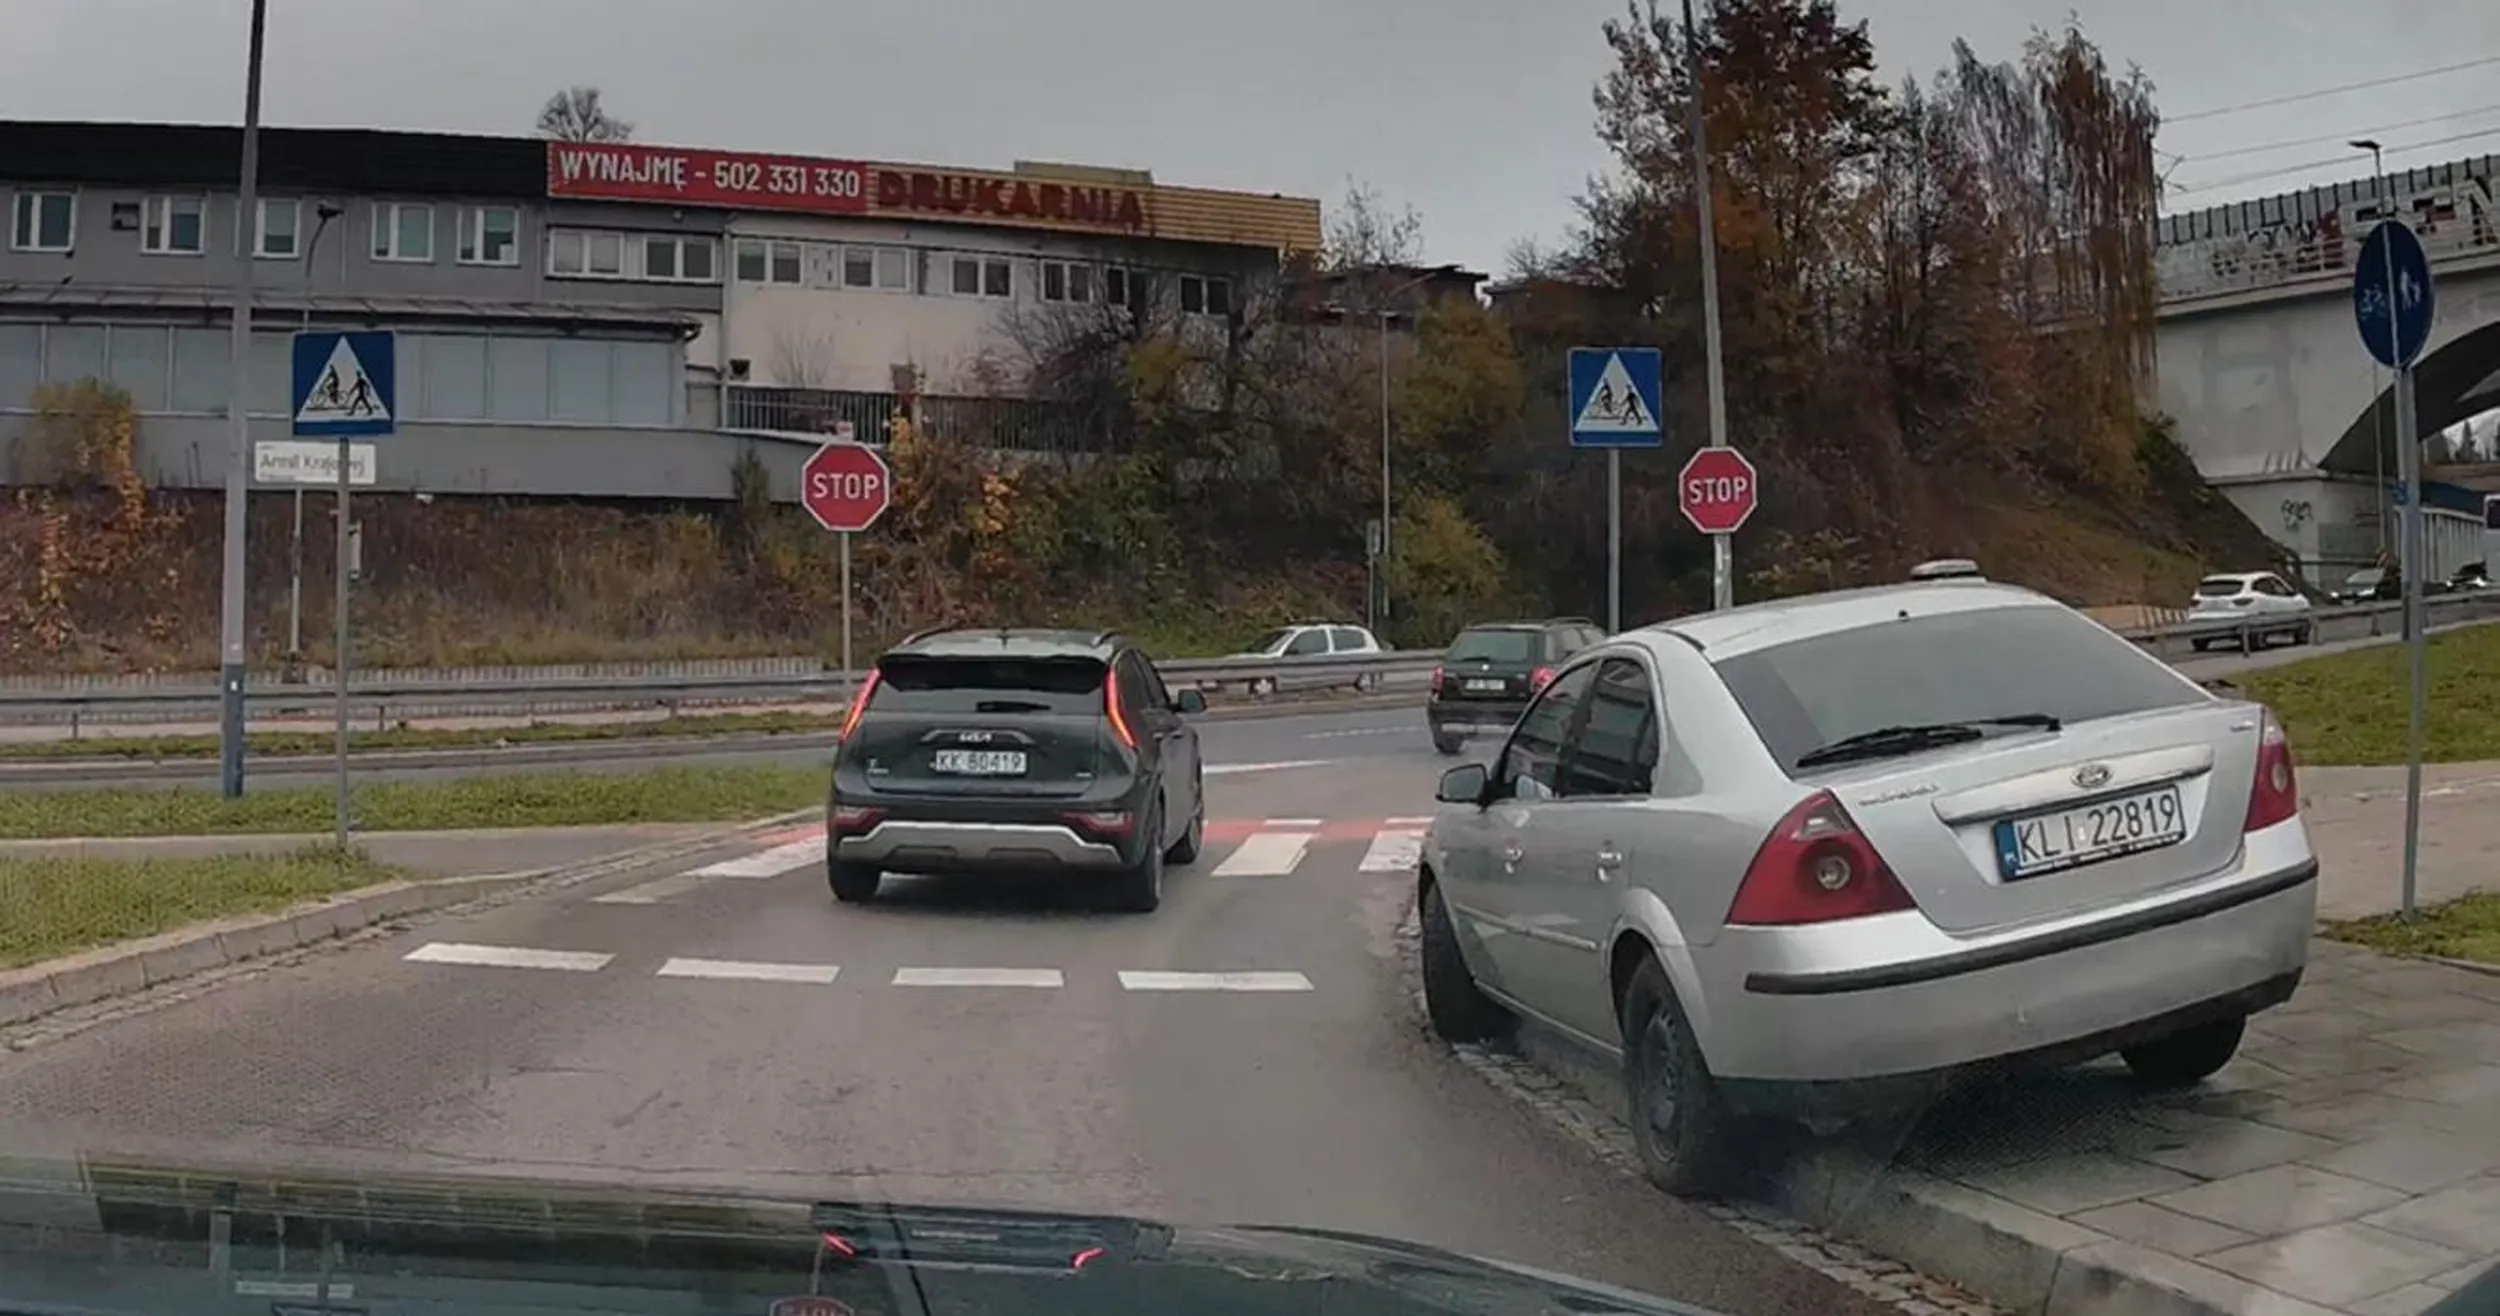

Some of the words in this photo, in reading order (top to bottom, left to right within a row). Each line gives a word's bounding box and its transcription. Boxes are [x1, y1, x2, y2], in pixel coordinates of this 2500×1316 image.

[559, 150, 688, 191] WYNAJMĘ
[713, 160, 762, 191] 502
[767, 163, 807, 195] 331
[814, 167, 860, 198] 330
[878, 170, 1145, 229] DRUKARNIA
[812, 472, 880, 500] STOP
[1688, 475, 1748, 505] STOP
[2019, 815, 2076, 863] KLI
[2086, 793, 2177, 848] 22819
